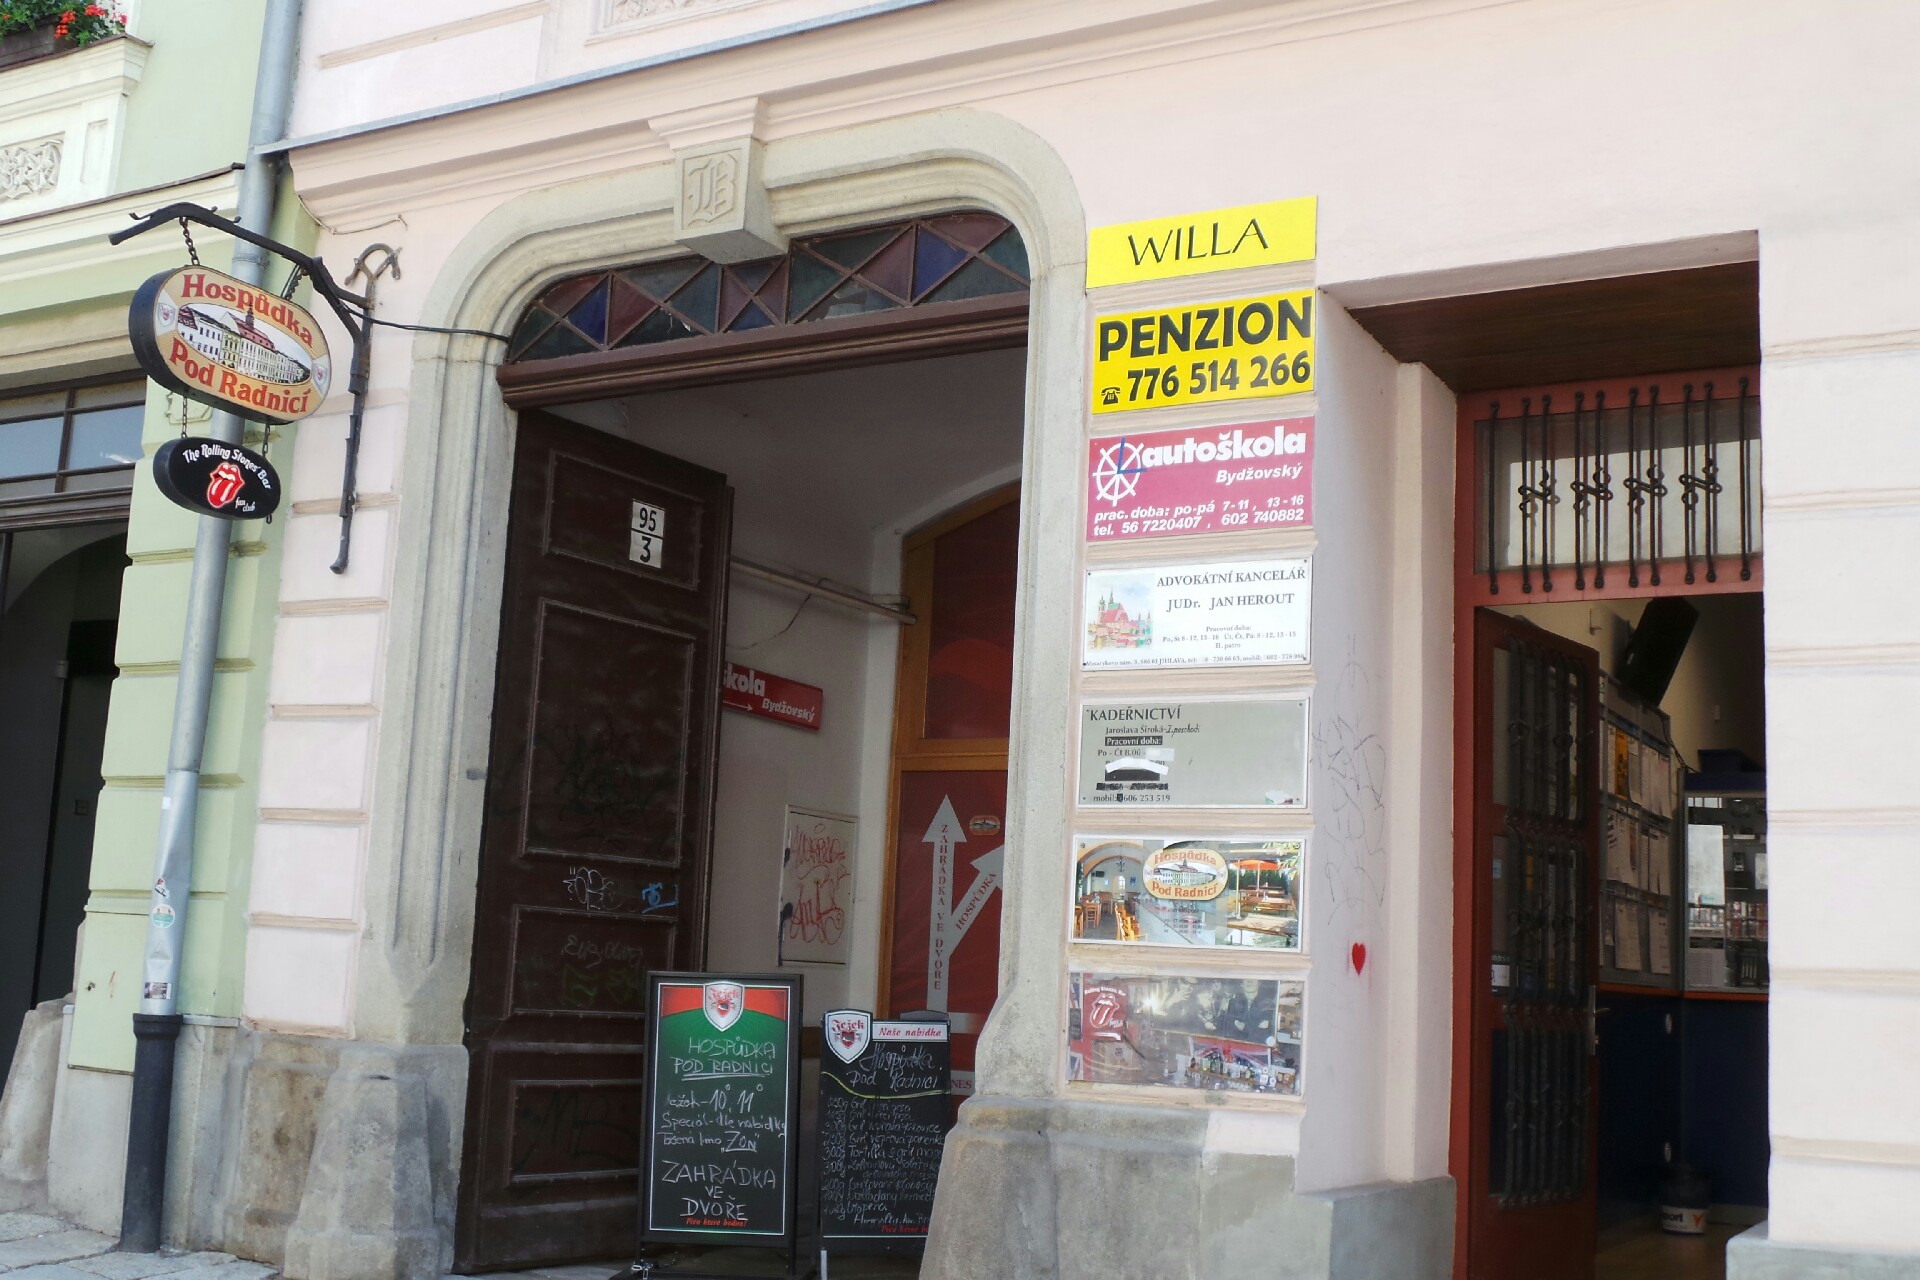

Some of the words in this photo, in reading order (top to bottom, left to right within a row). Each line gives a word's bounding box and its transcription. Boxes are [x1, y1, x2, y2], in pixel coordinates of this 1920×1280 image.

[1128, 218, 1269, 265] WILLA
[181, 273, 313, 348] Hospůdka
[1100, 296, 1312, 362] PENZION
[171, 337, 215, 387] Pod
[218, 370, 312, 414] Radnicí
[1127, 365, 1180, 402] 776
[1189, 358, 1240, 394] 514
[1250, 350, 1311, 388] 266
[1142, 425, 1307, 467] autoškola
[183, 448, 200, 464] The
[201, 443, 231, 460] Rolling
[257, 470, 272, 491] Bar
[1216, 462, 1304, 487] Bydžovský
[639, 507, 657, 532] 95
[1093, 523, 1114, 537] tel.
[1122, 521, 1139, 534] 56
[1142, 515, 1203, 533] 7220407
[1221, 512, 1248, 526] 602
[1253, 508, 1304, 525] 740882
[1094, 508, 1129, 524] prac.
[1131, 503, 1170, 520] doba:
[640, 535, 651, 563] 3
[1157, 570, 1235, 587] ADVOKÁTNÍ
[1236, 566, 1306, 582] KANCELÁŘ
[1166, 597, 1201, 613] JUDr.
[1209, 596, 1236, 611] JAN
[1237, 592, 1295, 607] HEROUT
[762, 698, 816, 722] Bydžovský
[1090, 704, 1181, 721] KADEŘNICTVÍ
[1105, 725, 1138, 735] Jaroslava
[1106, 737, 1139, 746] Pracovní
[1140, 736, 1162, 745] doba:
[1098, 749, 1107, 757] Po
[1154, 850, 1217, 865] Hospůdka
[1152, 881, 1172, 897] Pod
[1174, 884, 1218, 898] Radnicí
[879, 1027, 901, 1036] Naše
[688, 1036, 776, 1059] HOSPŮDKA
[670, 1056, 704, 1074] POD
[846, 1070, 877, 1088] Pod
[715, 1112, 735, 1128] dle
[661, 1160, 776, 1189] ZAHRÁDKA
[705, 1185, 724, 1199] VE
[680, 1195, 749, 1221] DVOŘE
